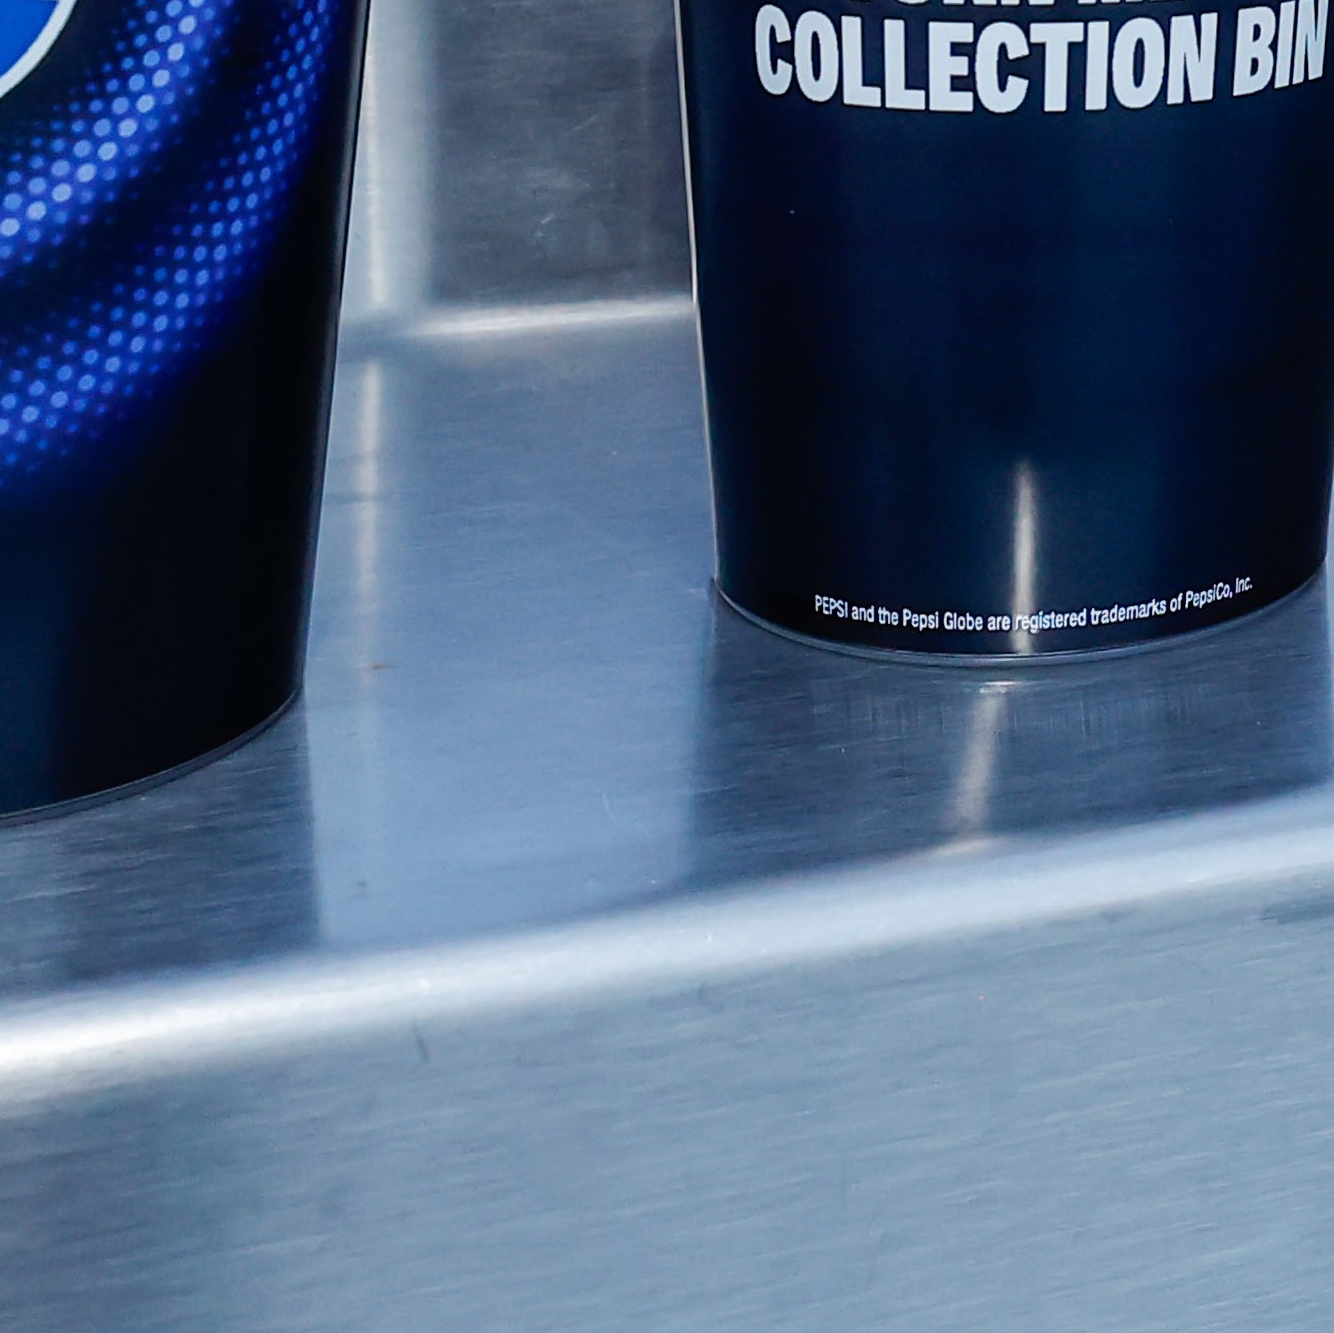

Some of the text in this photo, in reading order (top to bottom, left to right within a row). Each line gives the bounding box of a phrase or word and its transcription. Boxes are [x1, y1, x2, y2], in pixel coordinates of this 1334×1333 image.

[755, 5, 1218, 113] COLLECTION
[814, 576, 1254, 634] PEPSI and the Pepsi Globe are registered trademarks of PepsiCo, Inc.
